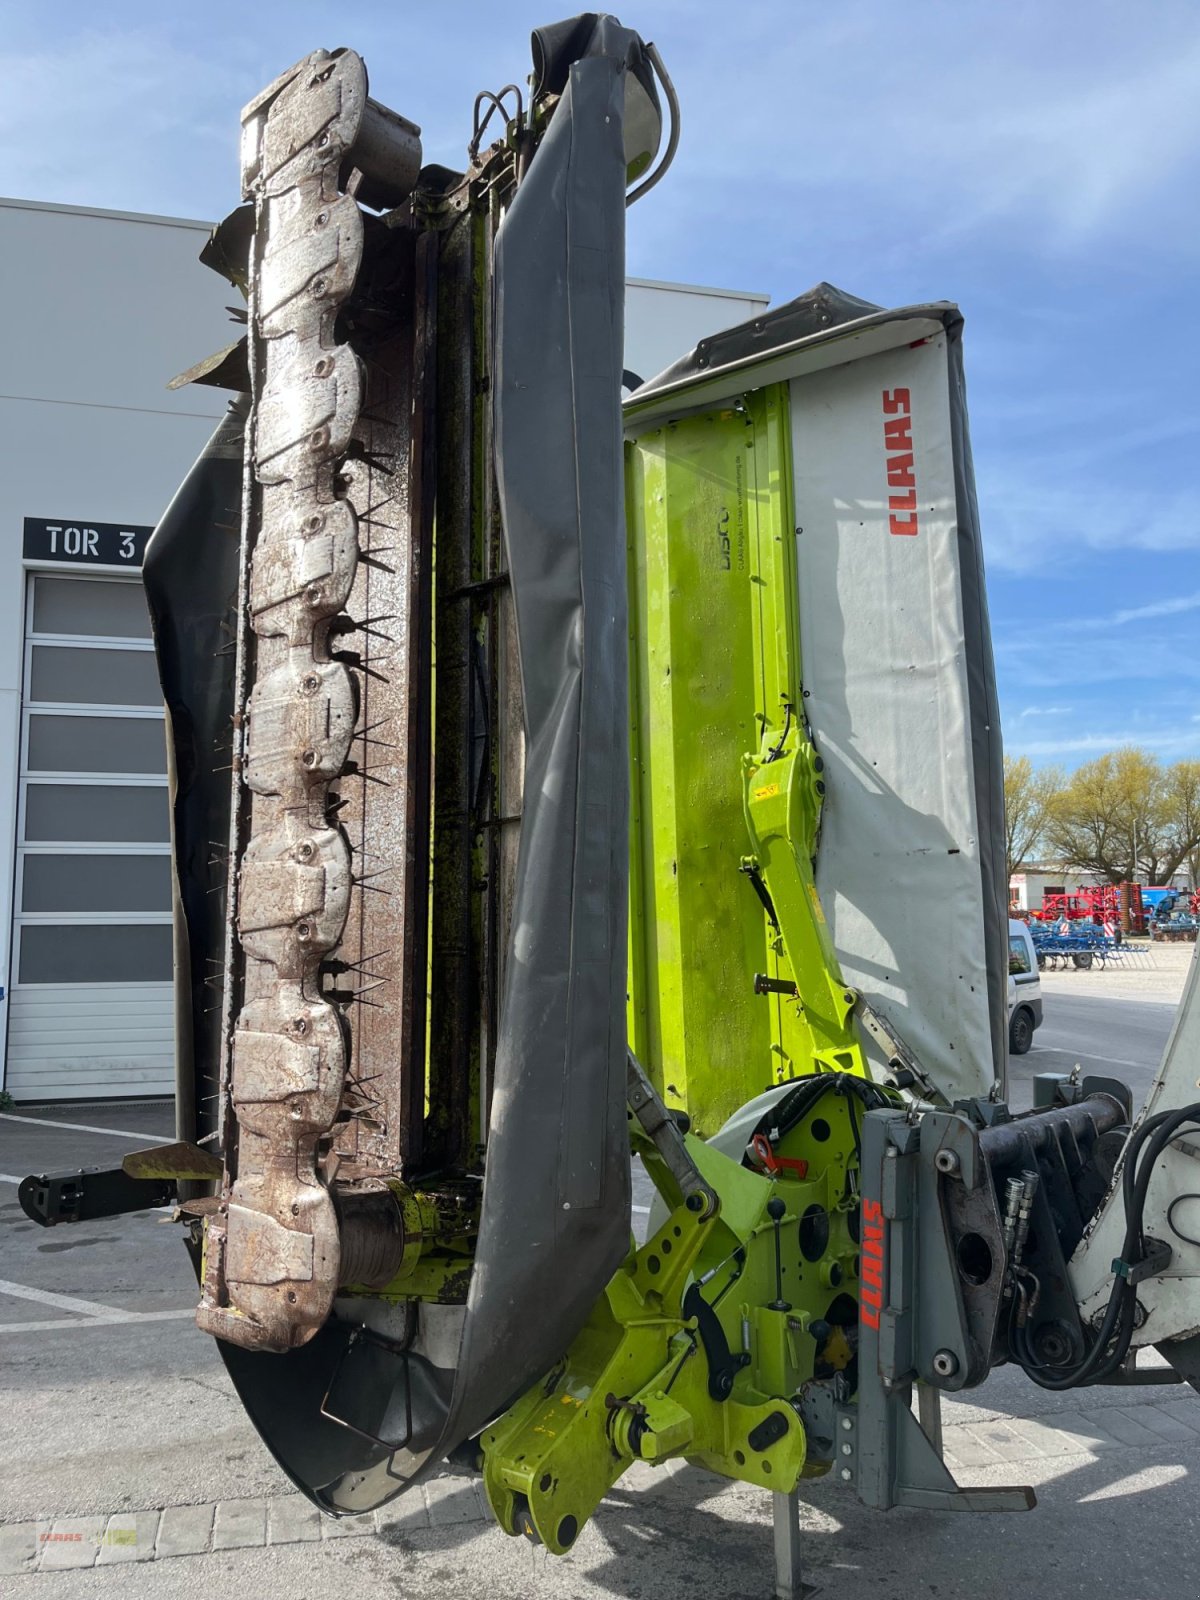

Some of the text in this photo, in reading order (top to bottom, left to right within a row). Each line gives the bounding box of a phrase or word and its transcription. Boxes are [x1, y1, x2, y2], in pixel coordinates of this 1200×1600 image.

[882, 387, 918, 536] CLAAS
[46, 526, 136, 559] TOR 3
[860, 1198, 884, 1332] CLAAS
